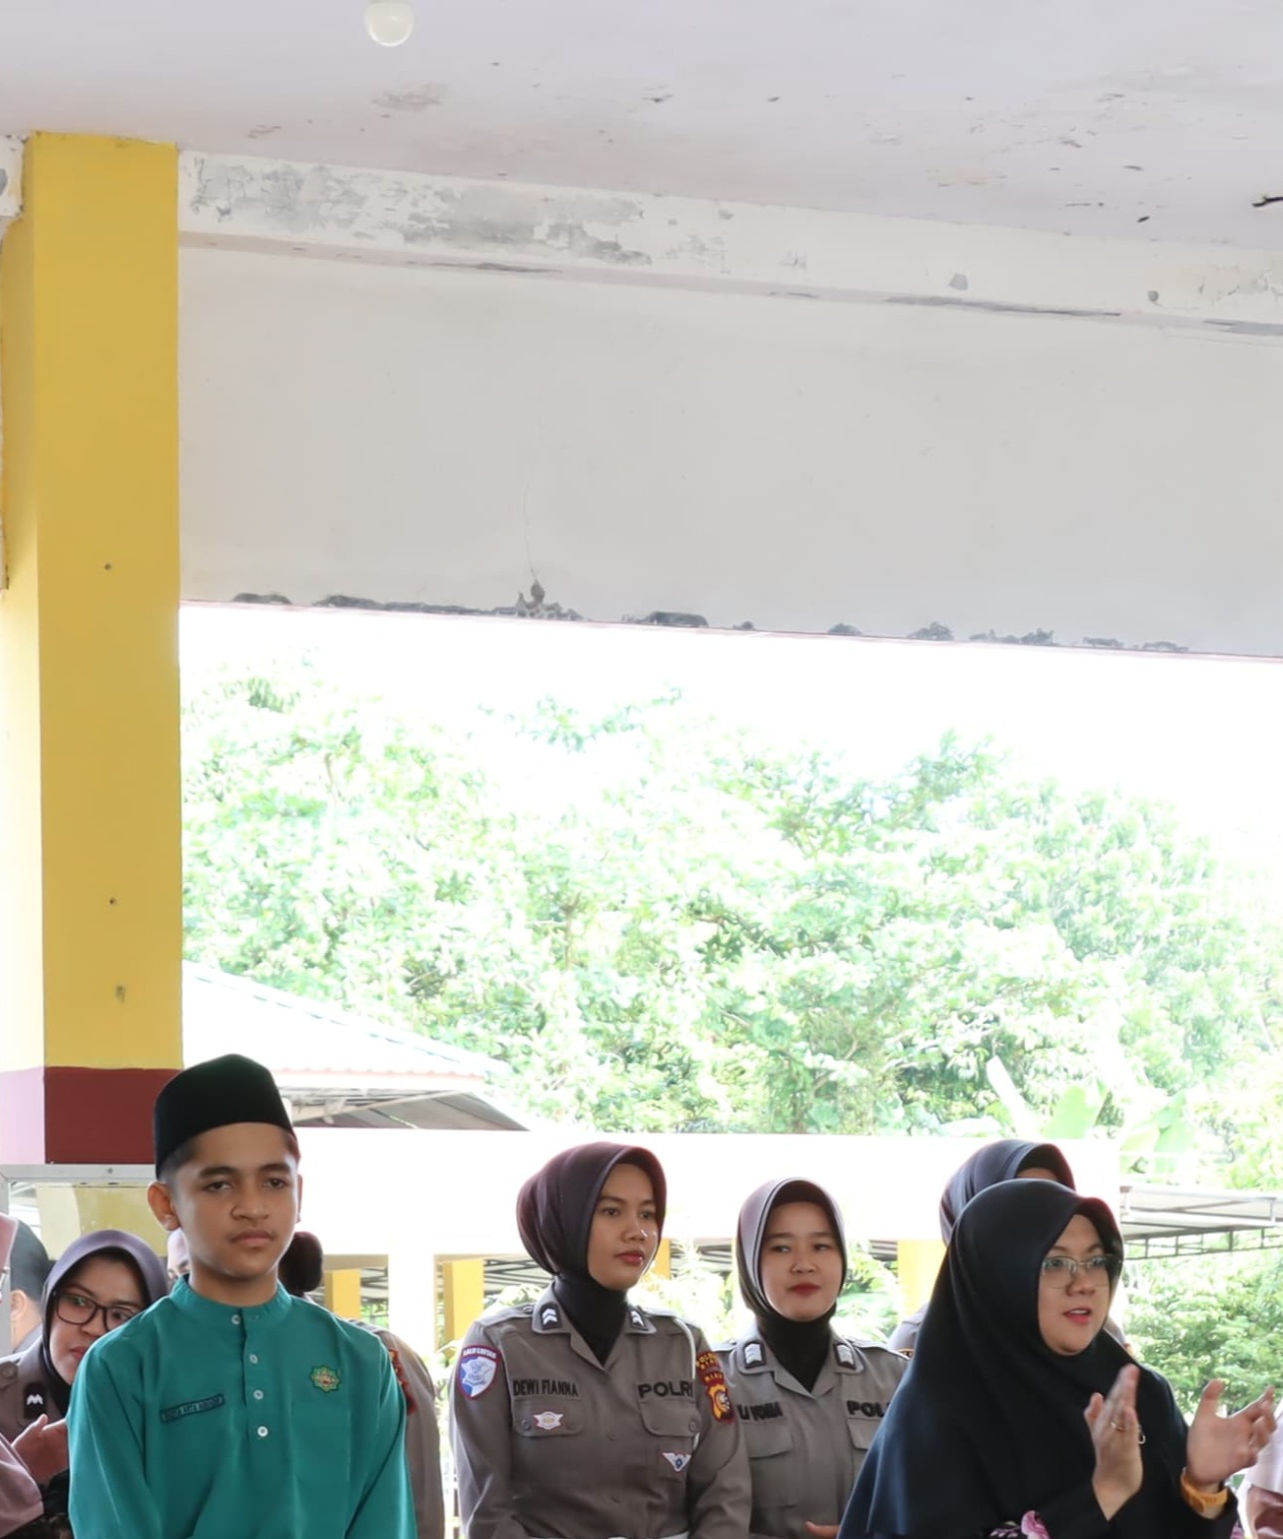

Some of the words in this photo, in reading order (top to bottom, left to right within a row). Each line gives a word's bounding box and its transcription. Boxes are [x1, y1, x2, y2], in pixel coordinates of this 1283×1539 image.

[512, 1379, 539, 1396] DEWI
[637, 1380, 694, 1399] POLRI
[846, 1400, 891, 1418] POL
